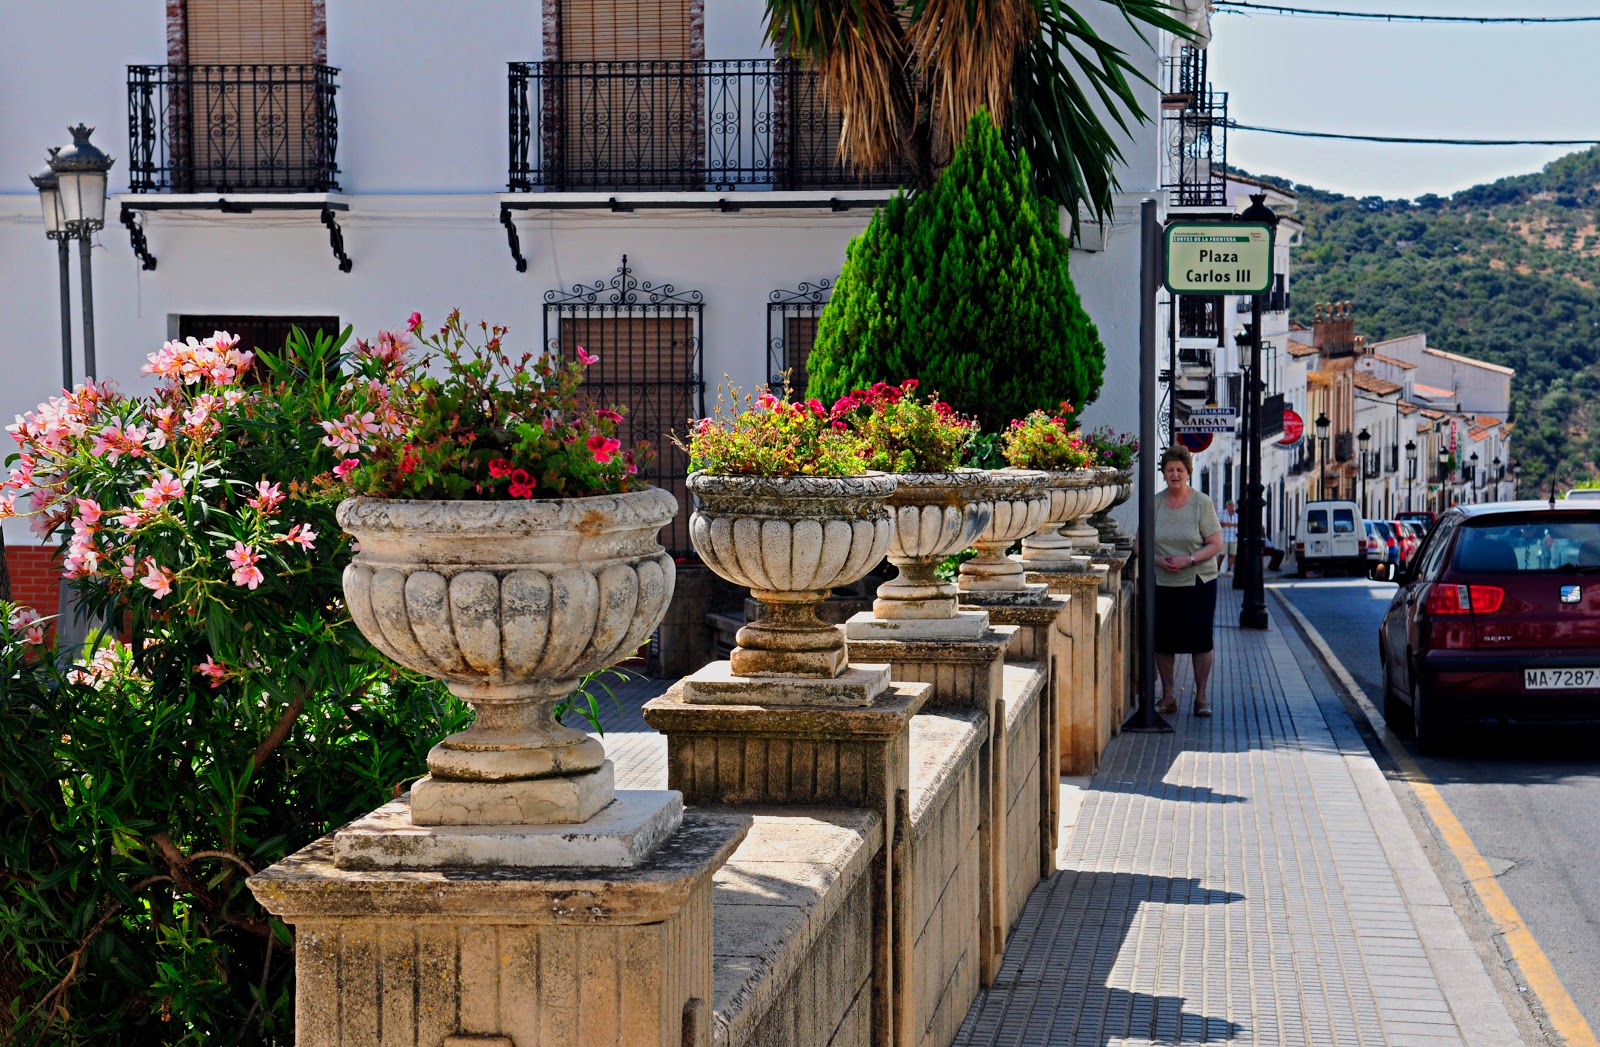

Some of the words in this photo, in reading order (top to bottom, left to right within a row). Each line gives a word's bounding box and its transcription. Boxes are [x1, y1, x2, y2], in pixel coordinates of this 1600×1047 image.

[1199, 250, 1238, 263] Plaza
[1186, 270, 1230, 282] Carlos
[1236, 270, 1250, 282] III
